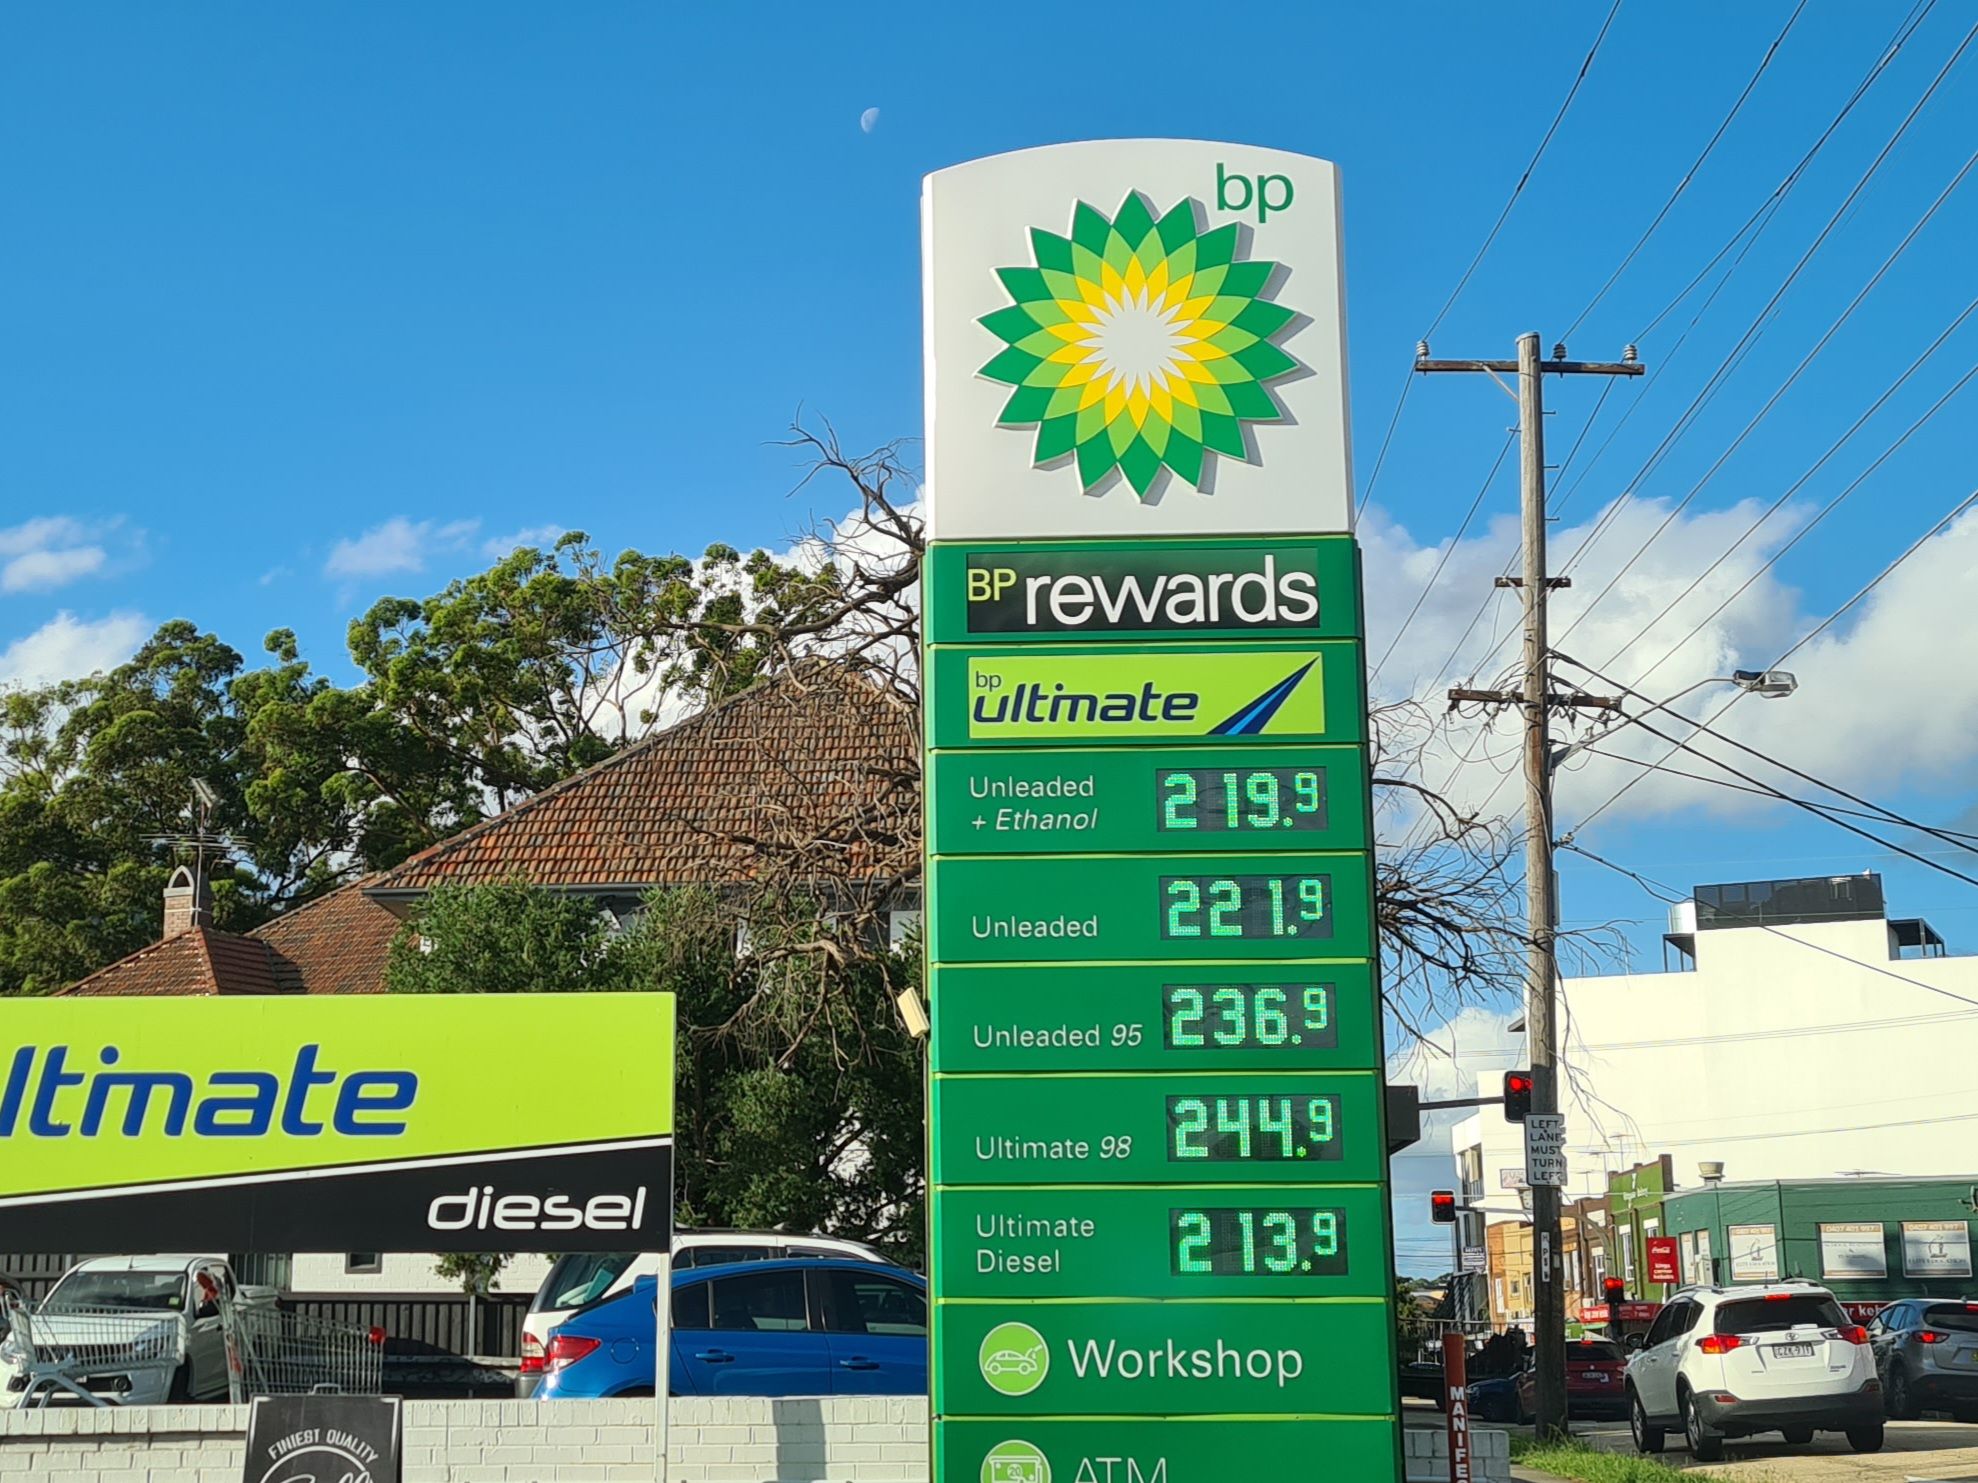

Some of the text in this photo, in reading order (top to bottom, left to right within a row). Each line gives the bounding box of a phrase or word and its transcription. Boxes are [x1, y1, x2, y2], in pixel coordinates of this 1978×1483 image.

[1216, 162, 1294, 223] bp
[967, 554, 1319, 625] BP rewards
[973, 682, 1199, 722] ultimate
[975, 671, 1002, 692] bp
[970, 772, 1319, 829] Unleaded 219.9
[971, 808, 1098, 831] + Ethanol
[972, 879, 1323, 938] Unleaded 221.9
[973, 987, 1328, 1048] Unleaded 95 236.9
[975, 1098, 1333, 1159] Ultimate 98 244.9
[1530, 1133, 1562, 1141] LANE
[1531, 1120, 1560, 1129] LEFT
[1531, 1146, 1560, 1154] MUST
[1532, 1159, 1562, 1168] TURN
[427, 1186, 647, 1230] diesel
[976, 1212, 1338, 1272] Ultimate 213.9
[976, 1249, 1060, 1273] Diesel
[1067, 1339, 1303, 1387] Workshop
[326, 1429, 379, 1464] QUALITY
[1450, 1386, 1469, 1483] MANIFE
[1075, 1457, 1166, 1483] ATM
